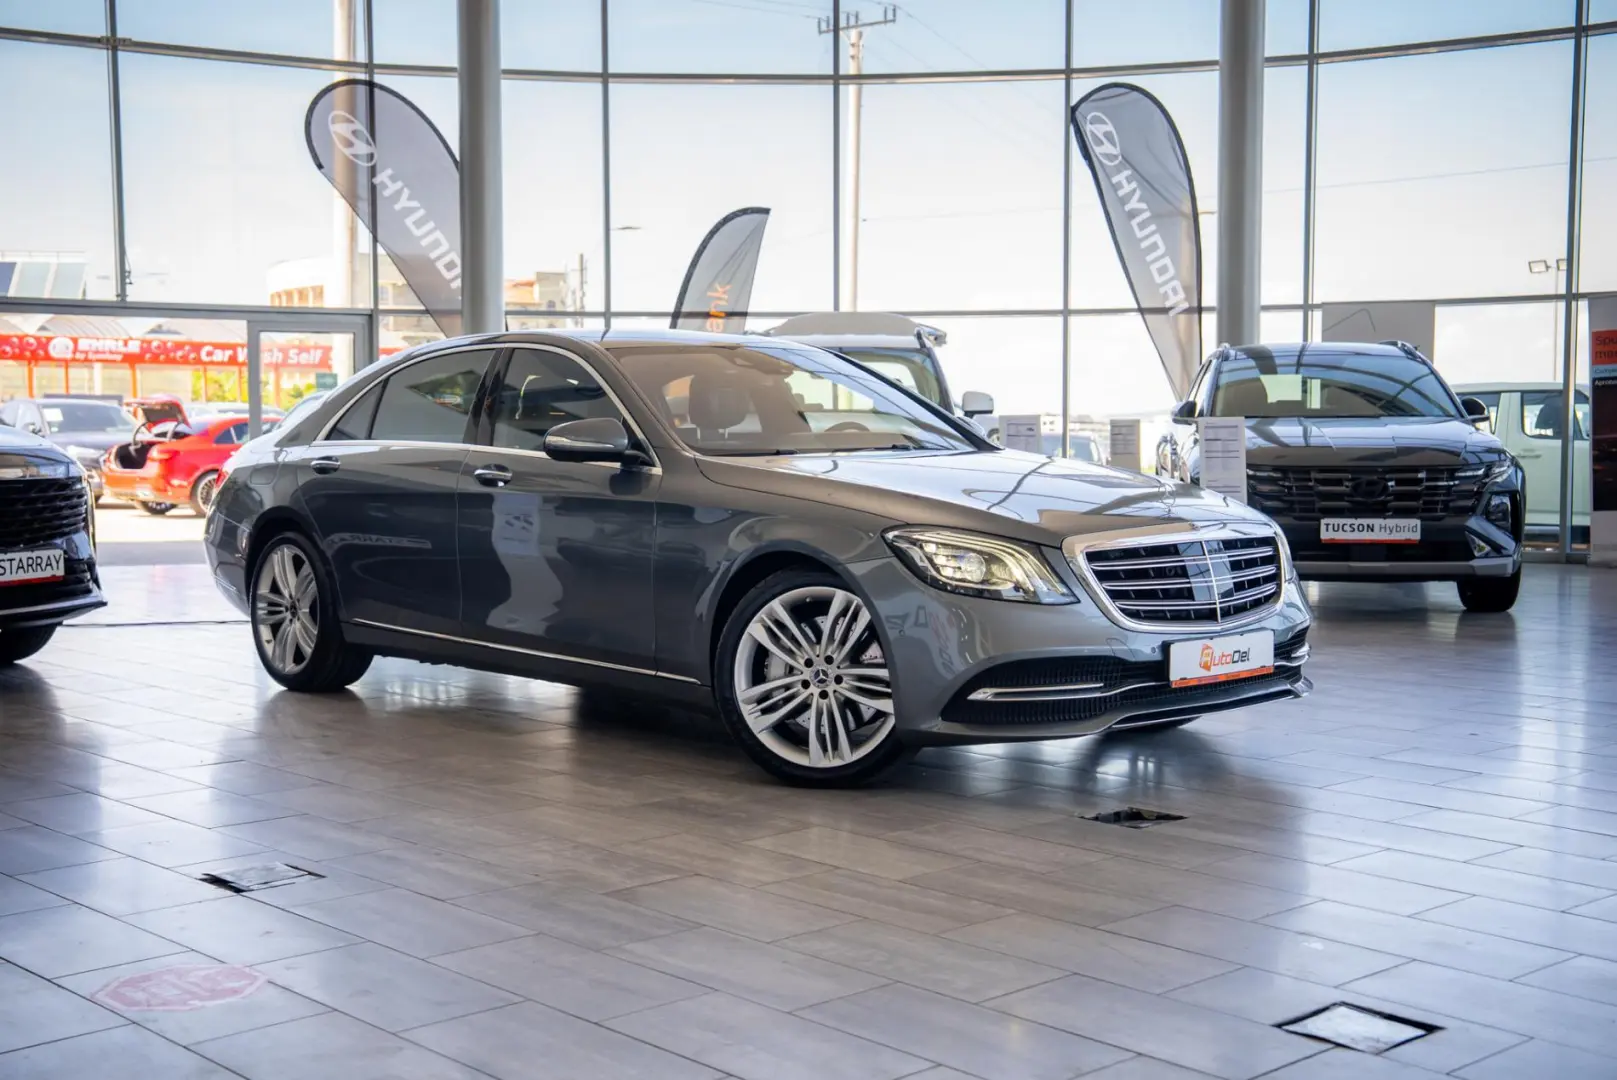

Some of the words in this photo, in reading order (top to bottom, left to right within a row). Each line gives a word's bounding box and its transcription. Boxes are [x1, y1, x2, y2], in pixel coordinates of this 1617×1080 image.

[372, 168, 461, 301] HYUND
[1111, 168, 1190, 317] HYUNDAI
[200, 345, 234, 363] Car
[287, 348, 324, 365] Self
[1323, 522, 1375, 533] TUCSON
[1379, 522, 1418, 536] Hybrid
[0, 554, 63, 577] STARRAY
[1199, 643, 1251, 672] AutoDel
